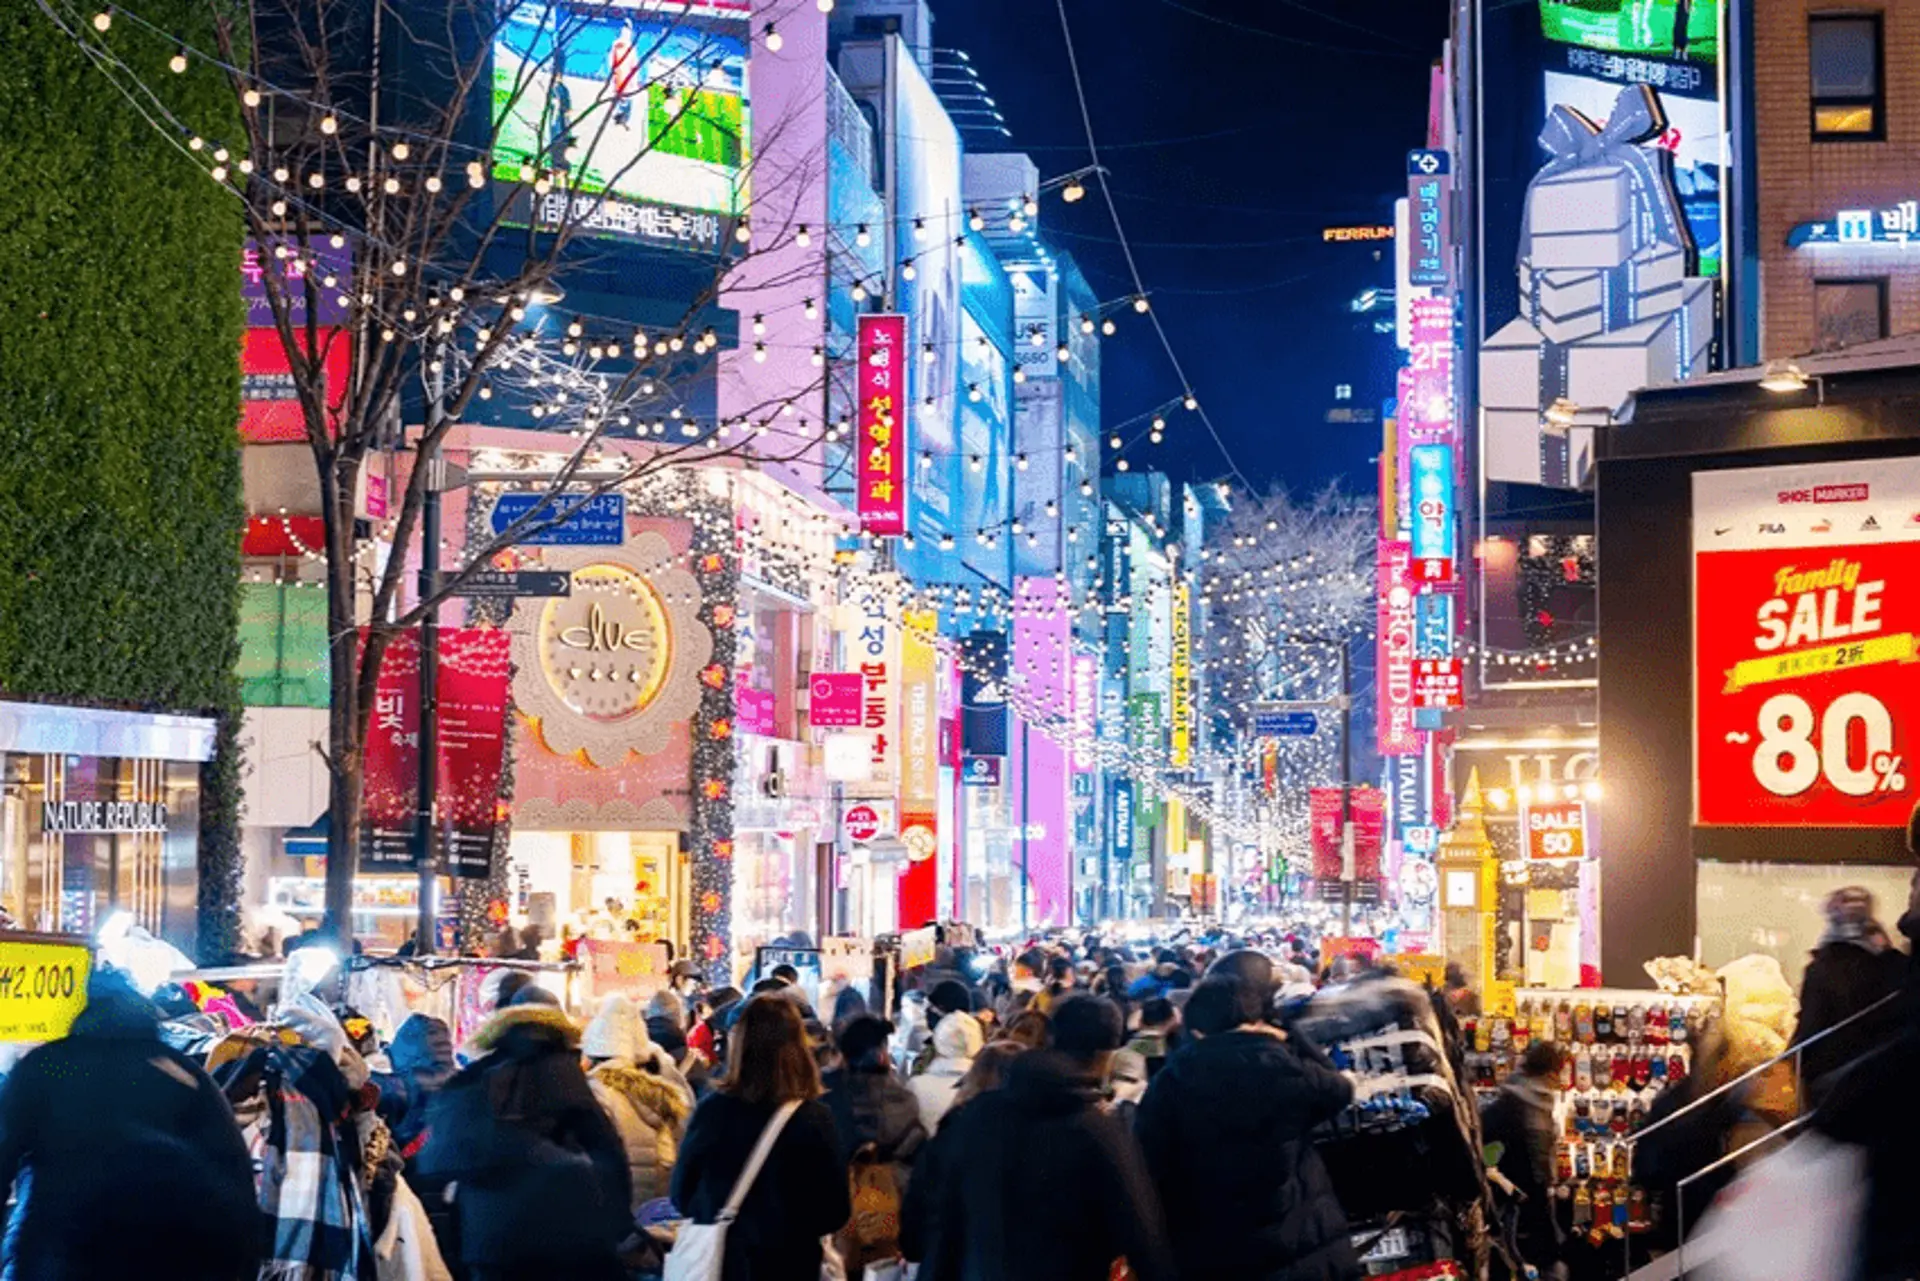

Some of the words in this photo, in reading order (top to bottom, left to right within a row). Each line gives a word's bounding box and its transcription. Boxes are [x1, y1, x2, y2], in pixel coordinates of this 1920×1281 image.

[1323, 226, 1394, 241] FERRUM
[1777, 491, 1811, 504] SHOE
[1815, 486, 1867, 502] MARKER
[1758, 523, 1786, 534] FILA
[1773, 558, 1861, 596] Family
[1754, 580, 1885, 651] SALE
[1388, 587, 1411, 704] ORCHID
[44, 801, 103, 831] NATURE
[105, 802, 168, 832] REPUBLIC
[1530, 811, 1581, 831] SALE
